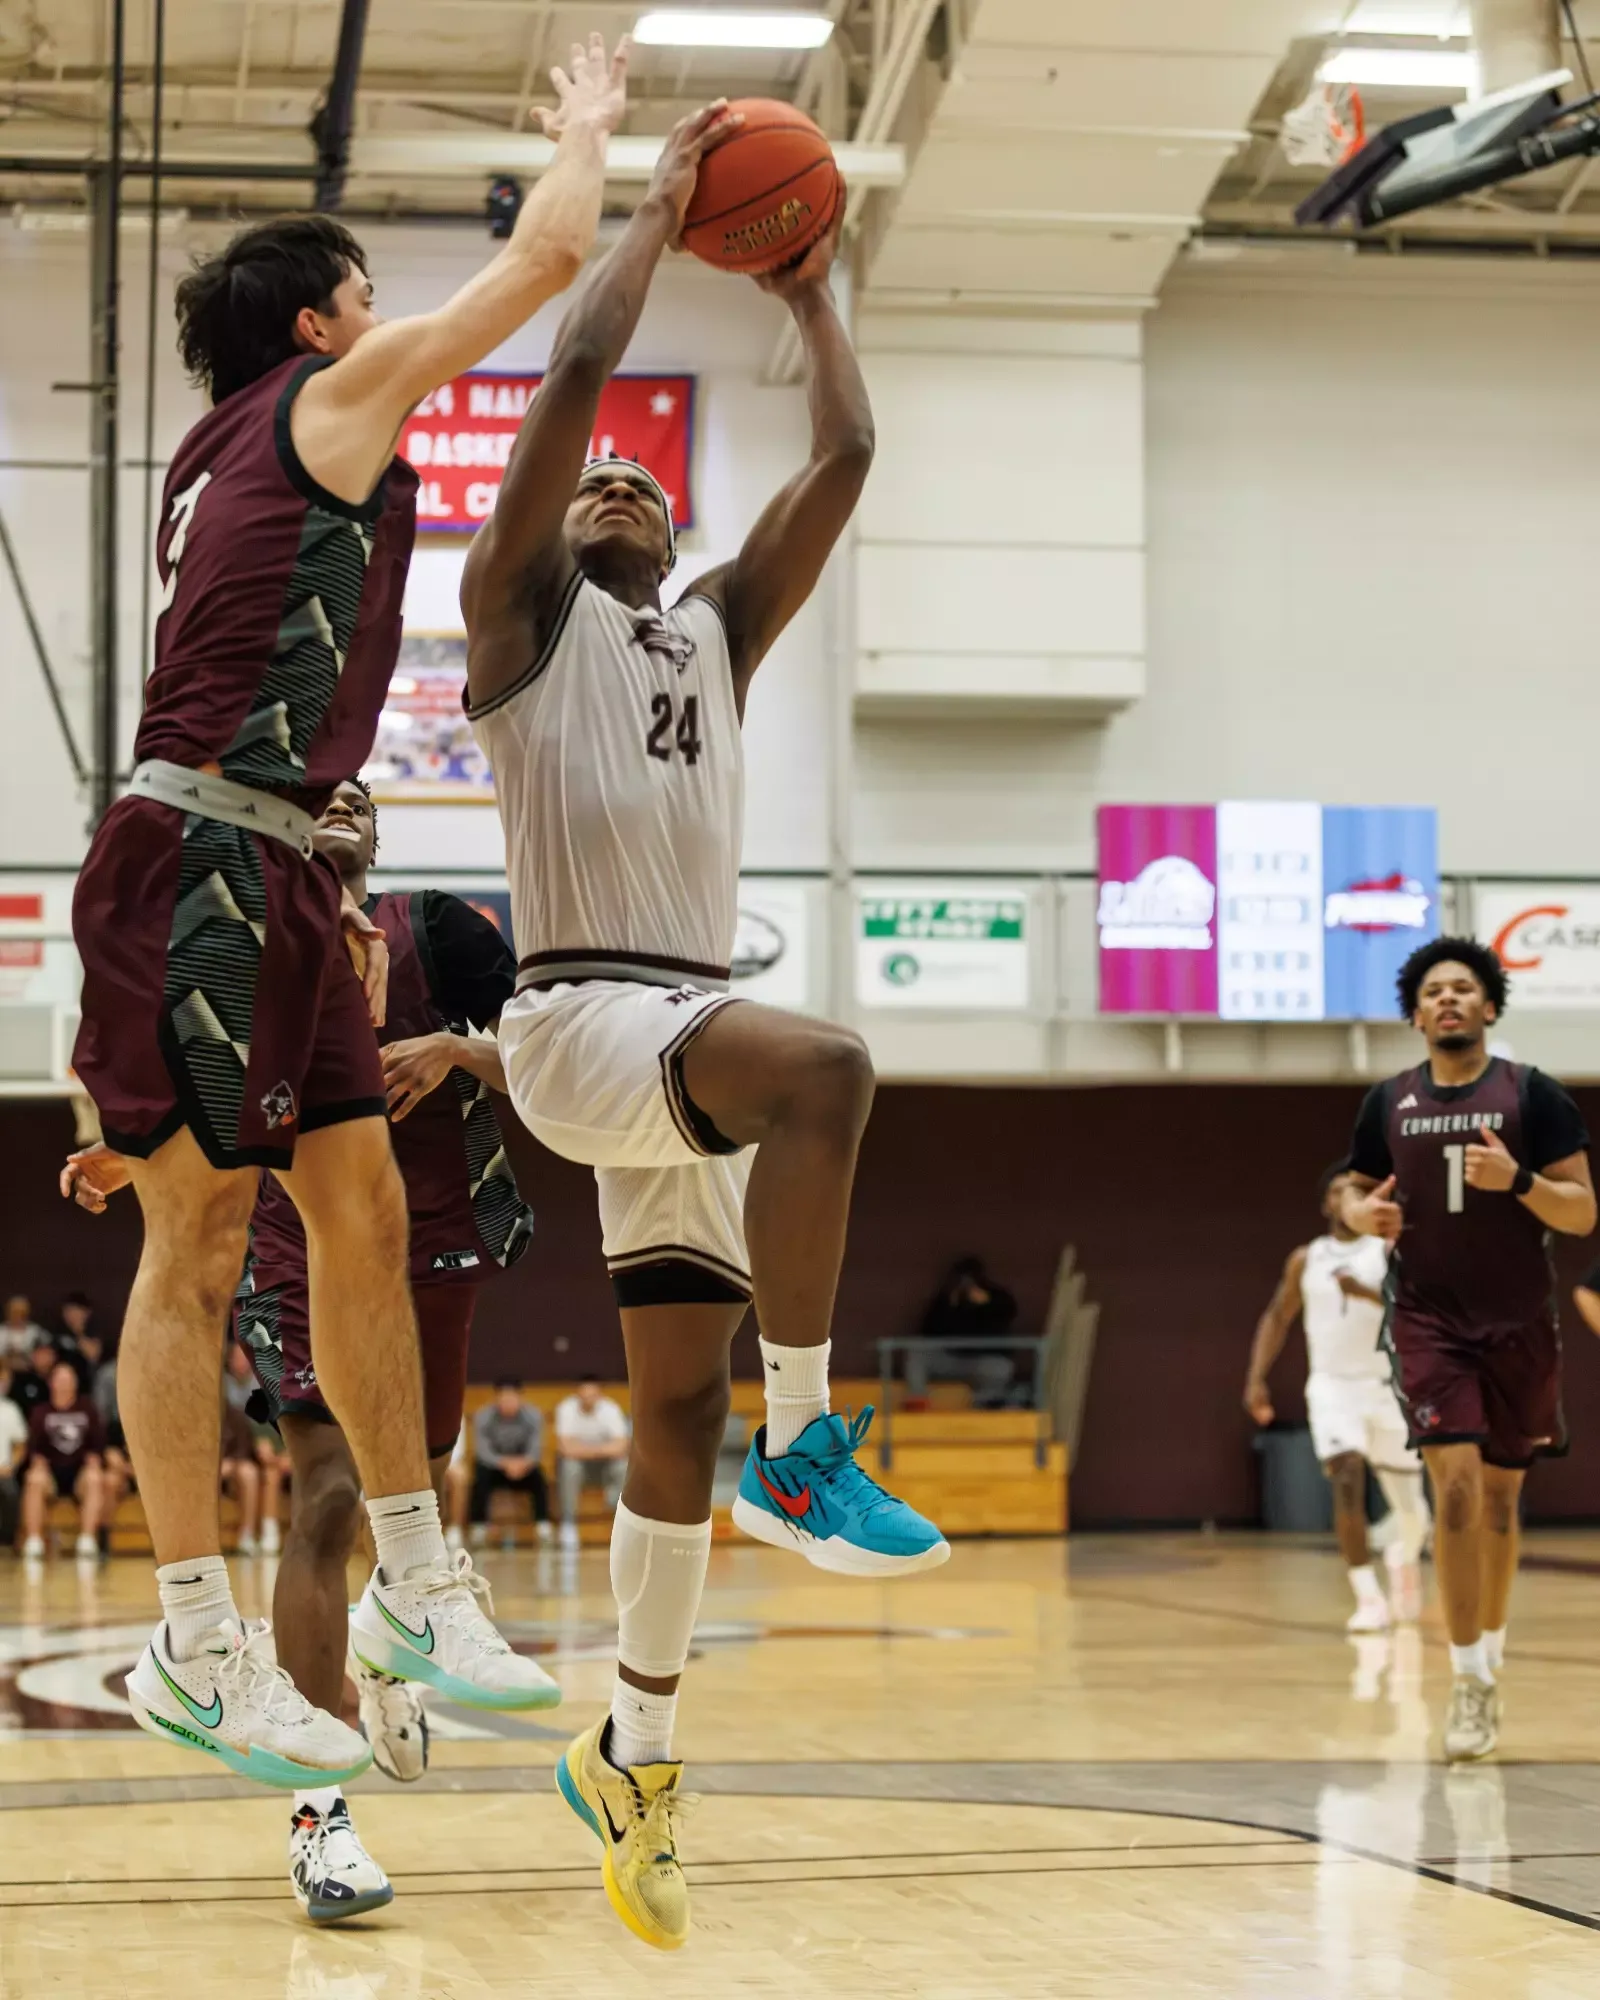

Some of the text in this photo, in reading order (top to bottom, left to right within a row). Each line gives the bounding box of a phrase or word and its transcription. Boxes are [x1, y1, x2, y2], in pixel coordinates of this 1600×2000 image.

[469, 384, 542, 418] NAI
[647, 692, 702, 766] 24
[1401, 1112, 1504, 1137] CUMBERLAND
[1443, 1144, 1464, 1214] 1
